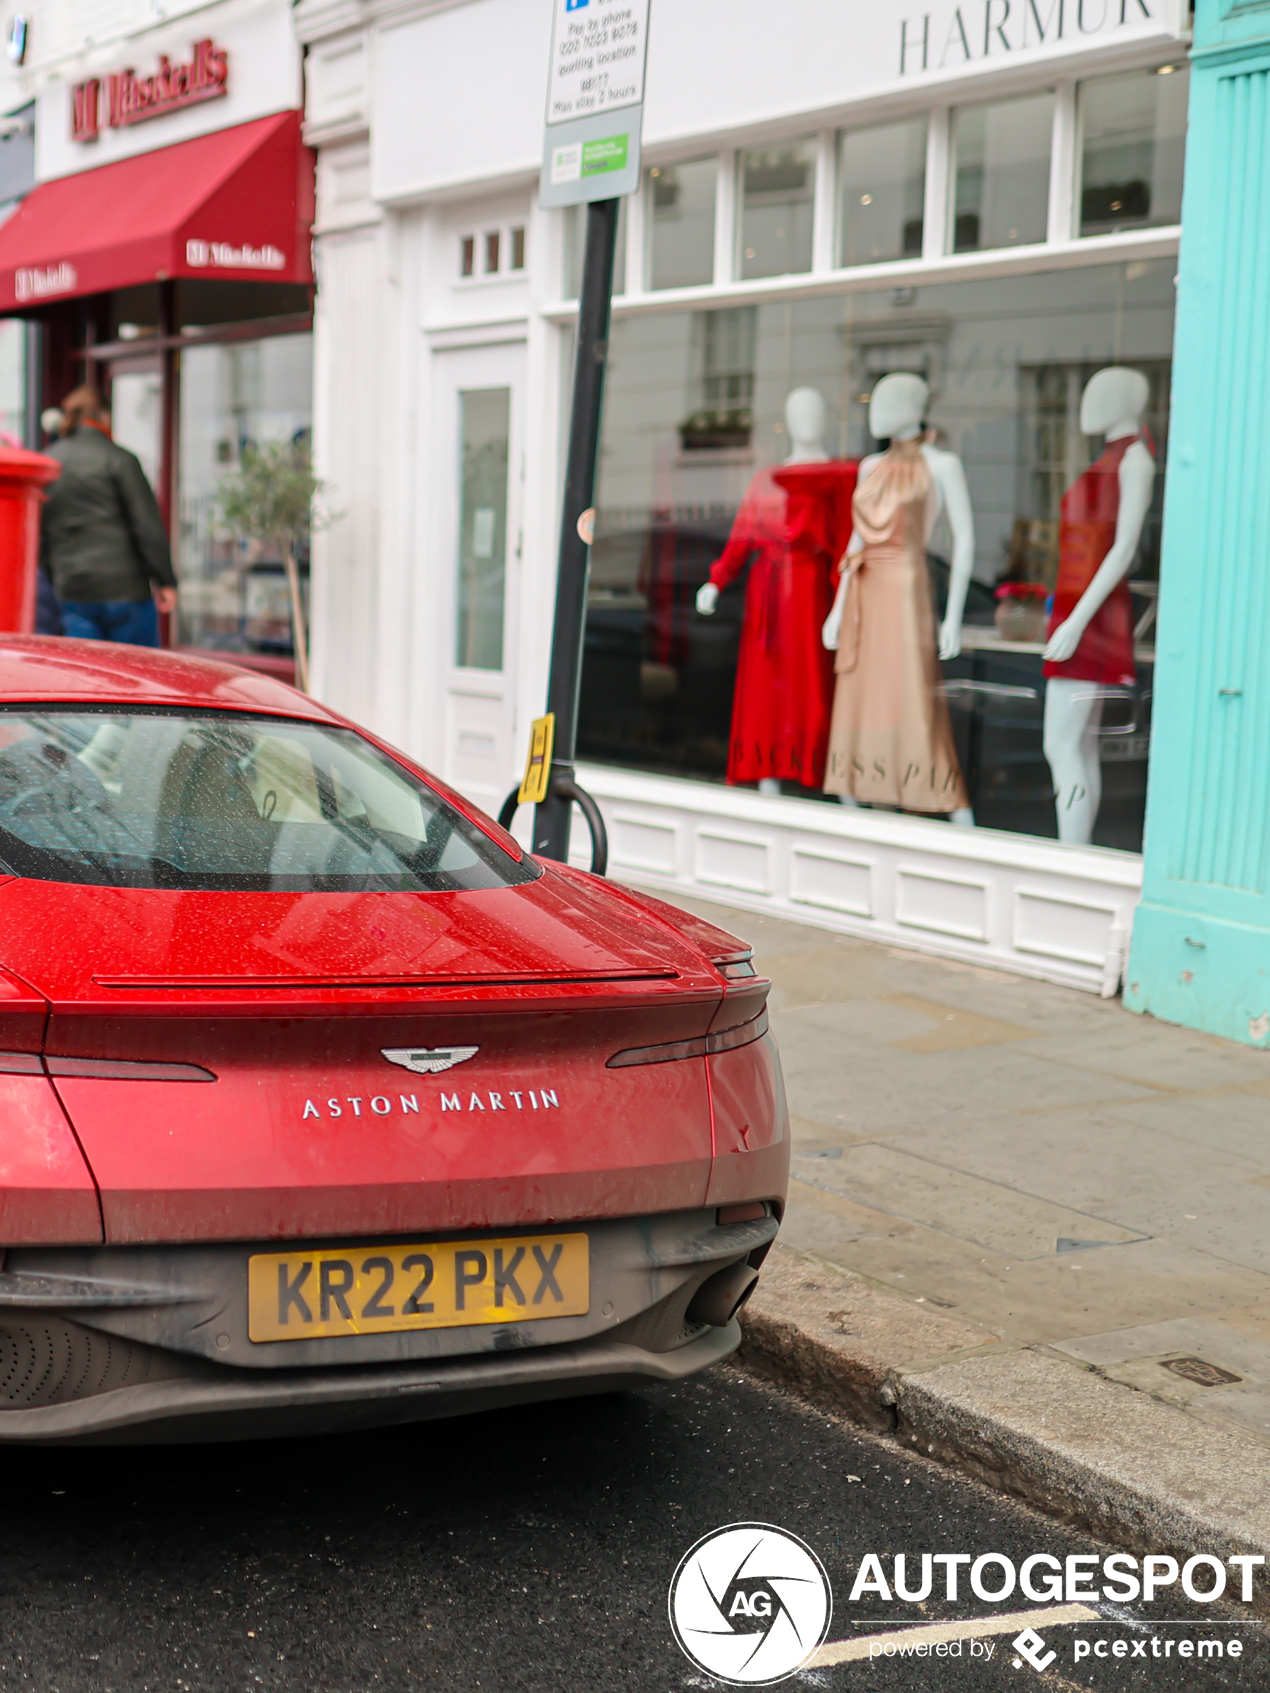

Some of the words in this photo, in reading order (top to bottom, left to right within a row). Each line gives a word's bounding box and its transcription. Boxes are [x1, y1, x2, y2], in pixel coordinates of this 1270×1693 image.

[568, 22, 584, 36] Pay
[588, 17, 598, 32] by
[601, 9, 632, 28] phone
[558, 56, 594, 76] quoting
[597, 45, 637, 65] location
[553, 99, 572, 115] Max
[576, 95, 595, 110] stay
[598, 90, 607, 105] 2
[608, 84, 636, 99] hours
[302, 1094, 420, 1119] ASTON
[441, 1089, 559, 1112] MARTIN
[277, 1253, 436, 1325] KR22
[454, 1243, 565, 1311] PKX
